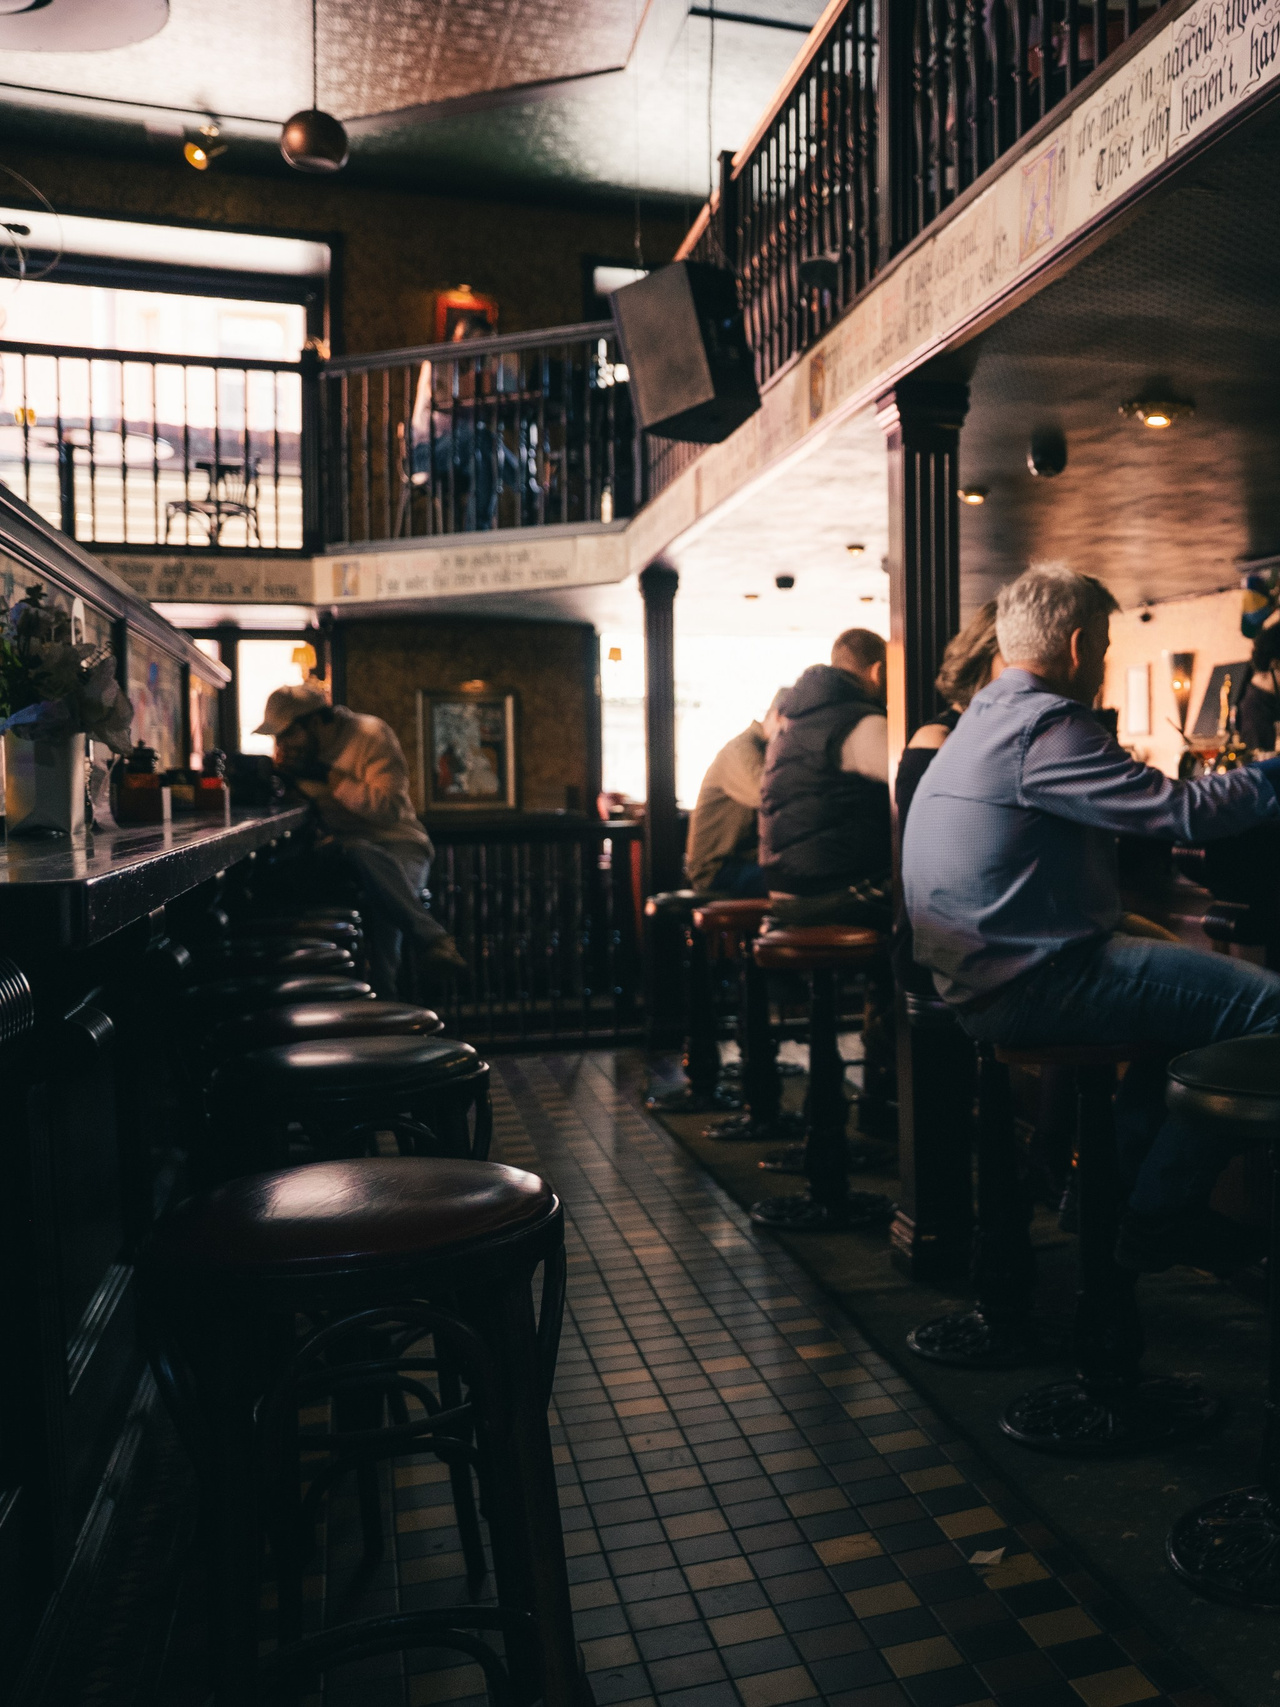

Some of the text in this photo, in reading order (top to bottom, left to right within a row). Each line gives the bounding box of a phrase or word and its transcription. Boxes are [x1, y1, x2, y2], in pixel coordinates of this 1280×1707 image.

[1140, 66, 1153, 104] in
[1161, 3, 1217, 88] narrow
[1095, 136, 1134, 192] Those
[1179, 54, 1237, 134] haven't,
